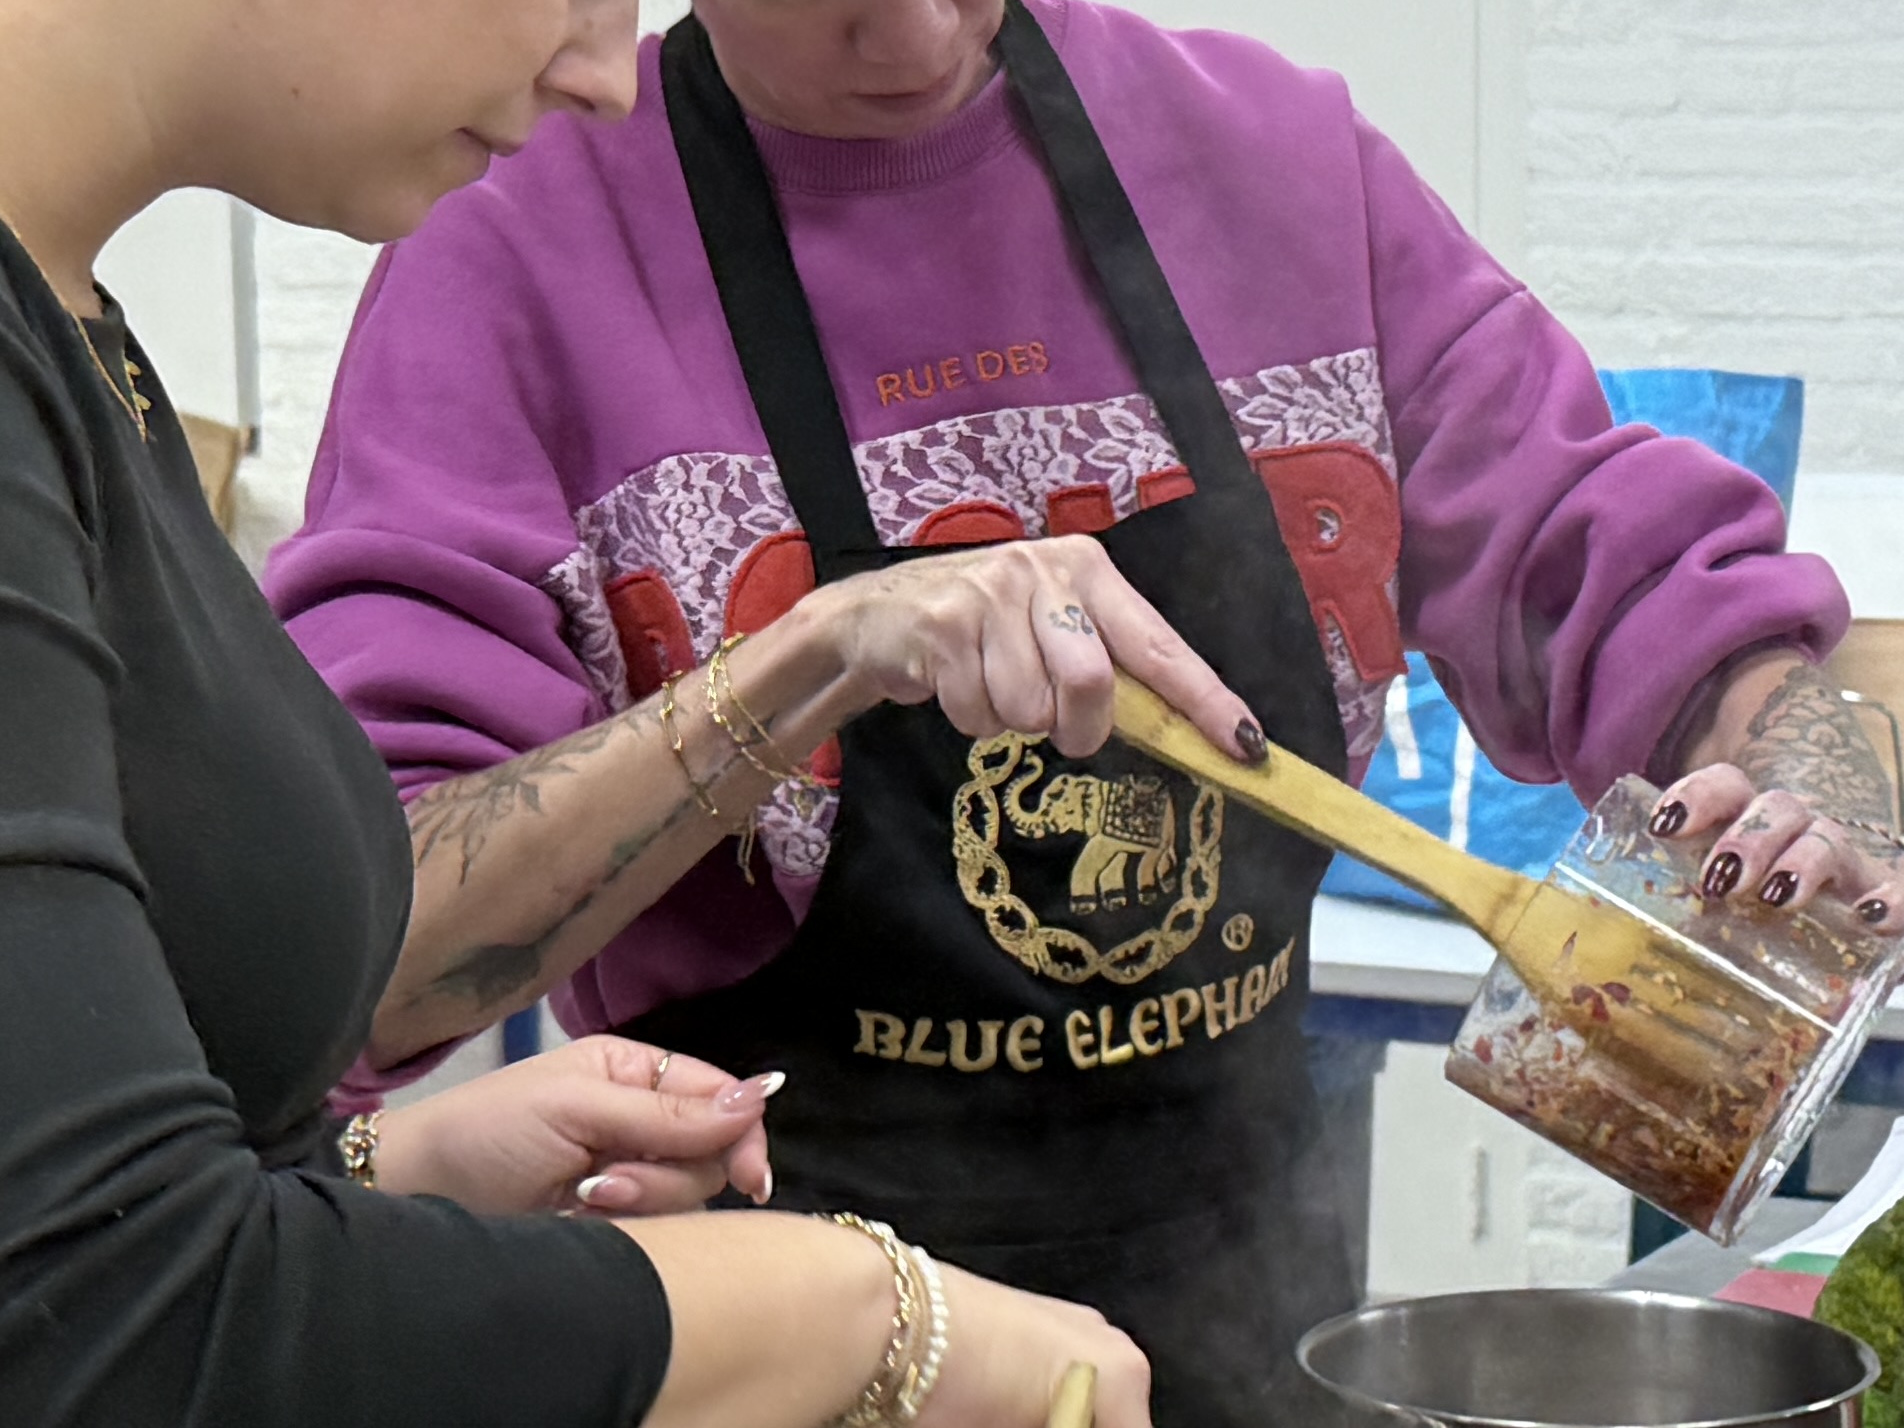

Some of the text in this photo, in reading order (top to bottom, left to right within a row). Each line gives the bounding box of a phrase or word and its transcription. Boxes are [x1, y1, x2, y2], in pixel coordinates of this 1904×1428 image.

[875, 340, 1050, 406] RUE DES
[852, 935, 1295, 1074] BLUE ELEPHAN
